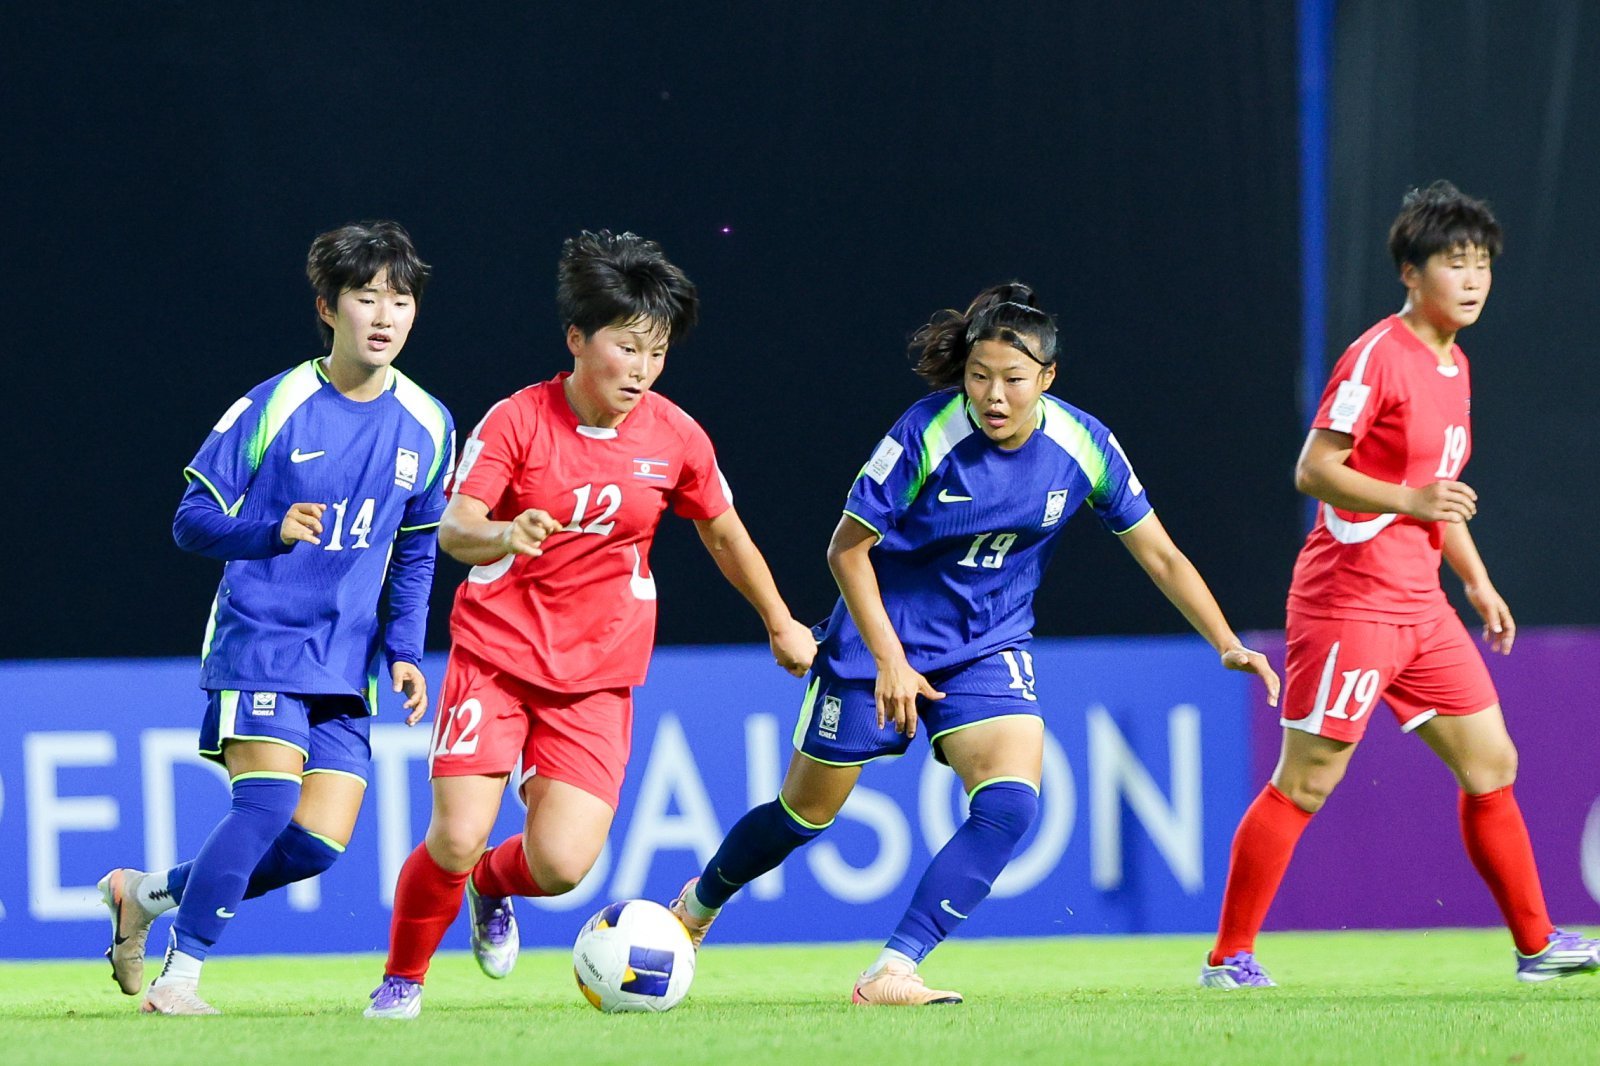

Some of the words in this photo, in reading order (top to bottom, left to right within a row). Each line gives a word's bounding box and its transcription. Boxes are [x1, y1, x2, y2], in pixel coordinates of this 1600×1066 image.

[1434, 423, 1468, 478] 19
[324, 498, 376, 551] 14
[561, 483, 622, 535] 12
[957, 533, 1017, 569] 19
[1325, 669, 1380, 722] 19
[433, 698, 483, 756] 12
[581, 952, 603, 981] molten
